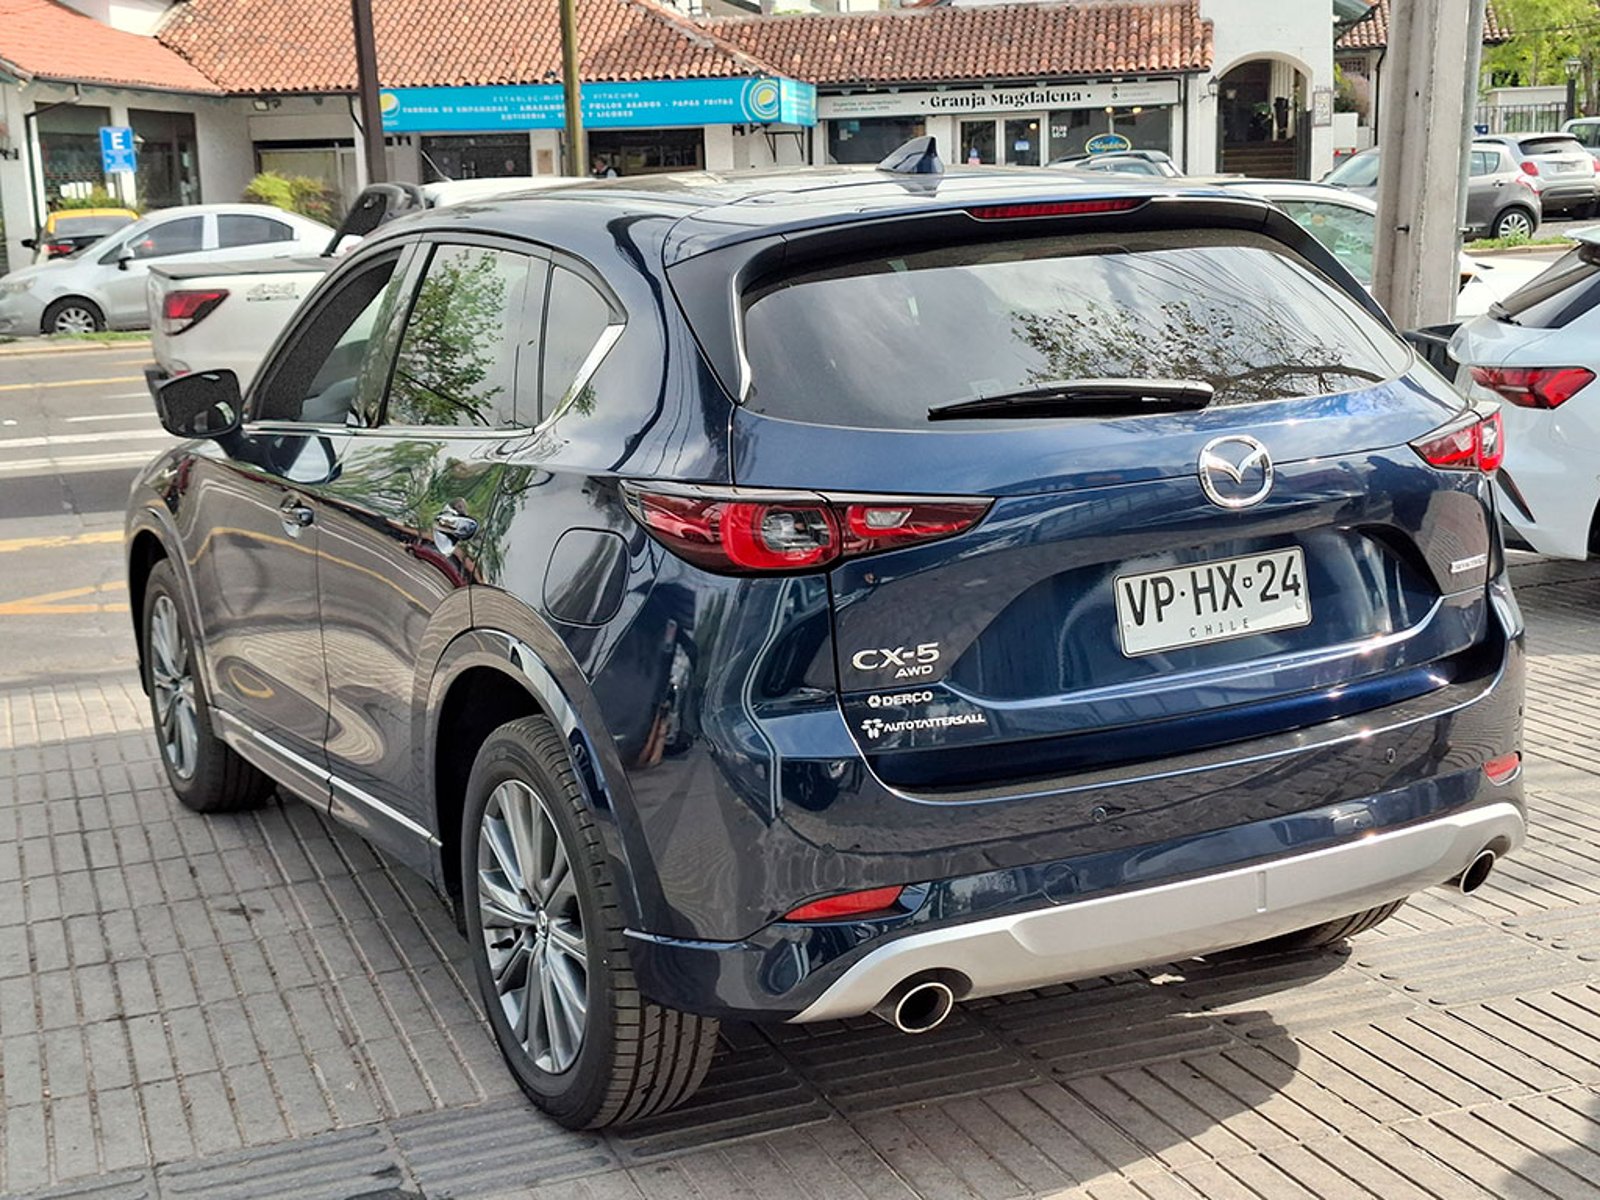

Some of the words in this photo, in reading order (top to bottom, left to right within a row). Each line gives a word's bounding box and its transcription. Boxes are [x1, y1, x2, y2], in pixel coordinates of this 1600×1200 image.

[930, 93, 986, 109] Granja
[991, 90, 1081, 107] Magdalena
[112, 132, 125, 150] E
[1189, 618, 1249, 638] CHILE
[852, 642, 940, 670] CX-5
[895, 665, 934, 679] AWD
[882, 691, 934, 706] DERCO
[883, 714, 986, 733] AUTOTATTERSALL
